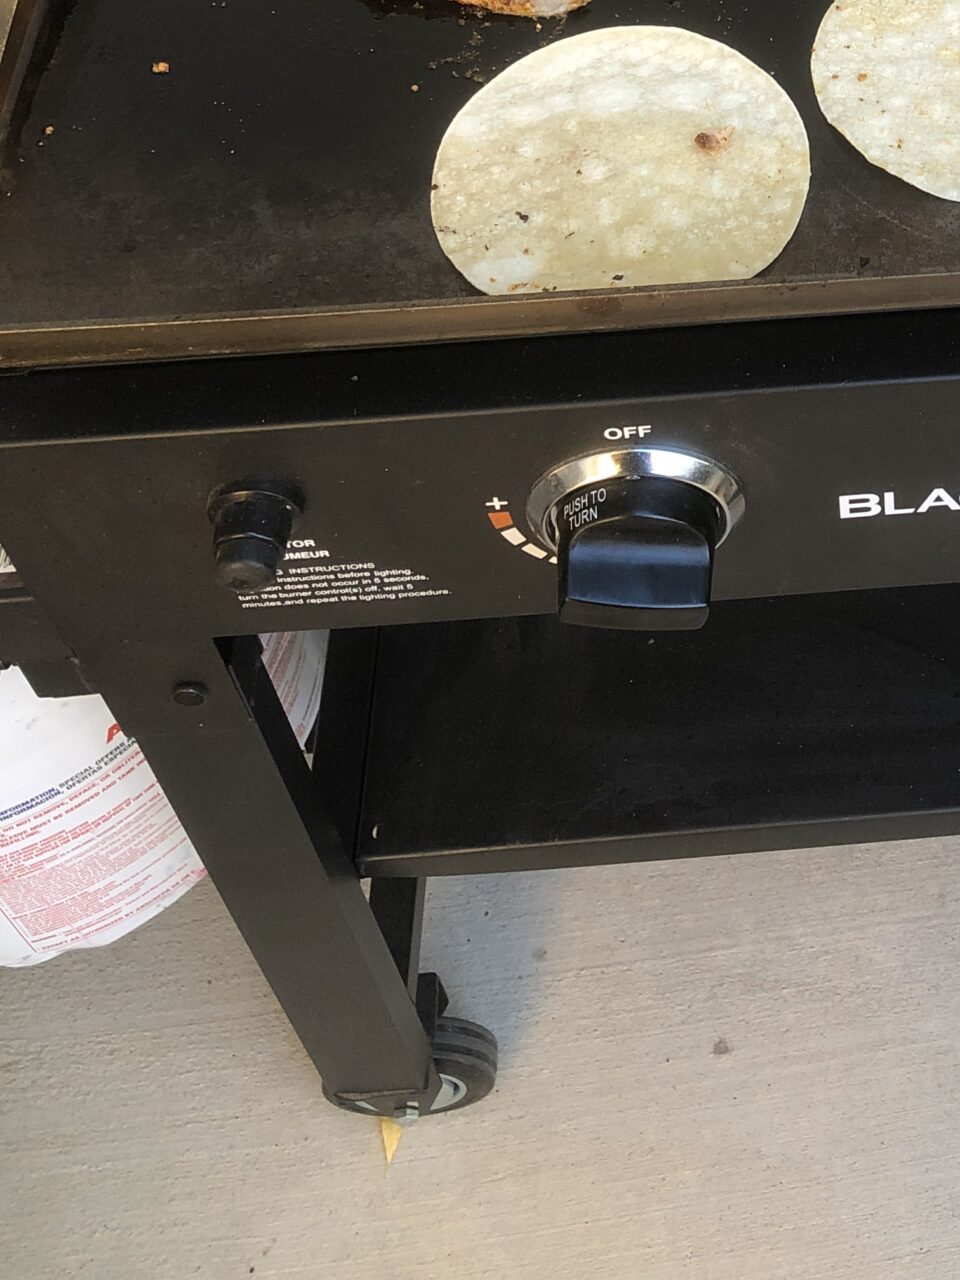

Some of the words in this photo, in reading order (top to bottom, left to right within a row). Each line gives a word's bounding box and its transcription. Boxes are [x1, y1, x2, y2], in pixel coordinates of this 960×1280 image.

[604, 424, 652, 440] OFF
[563, 493, 588, 520] PUSH
[590, 487, 607, 504] TO
[568, 506, 598, 531] TURN
[289, 562, 375, 574] INSTRUCTIONS
[337, 571, 371, 579] before
[314, 587, 363, 596] control(s)
[306, 596, 339, 604] repeat
[359, 593, 396, 602] lighting
